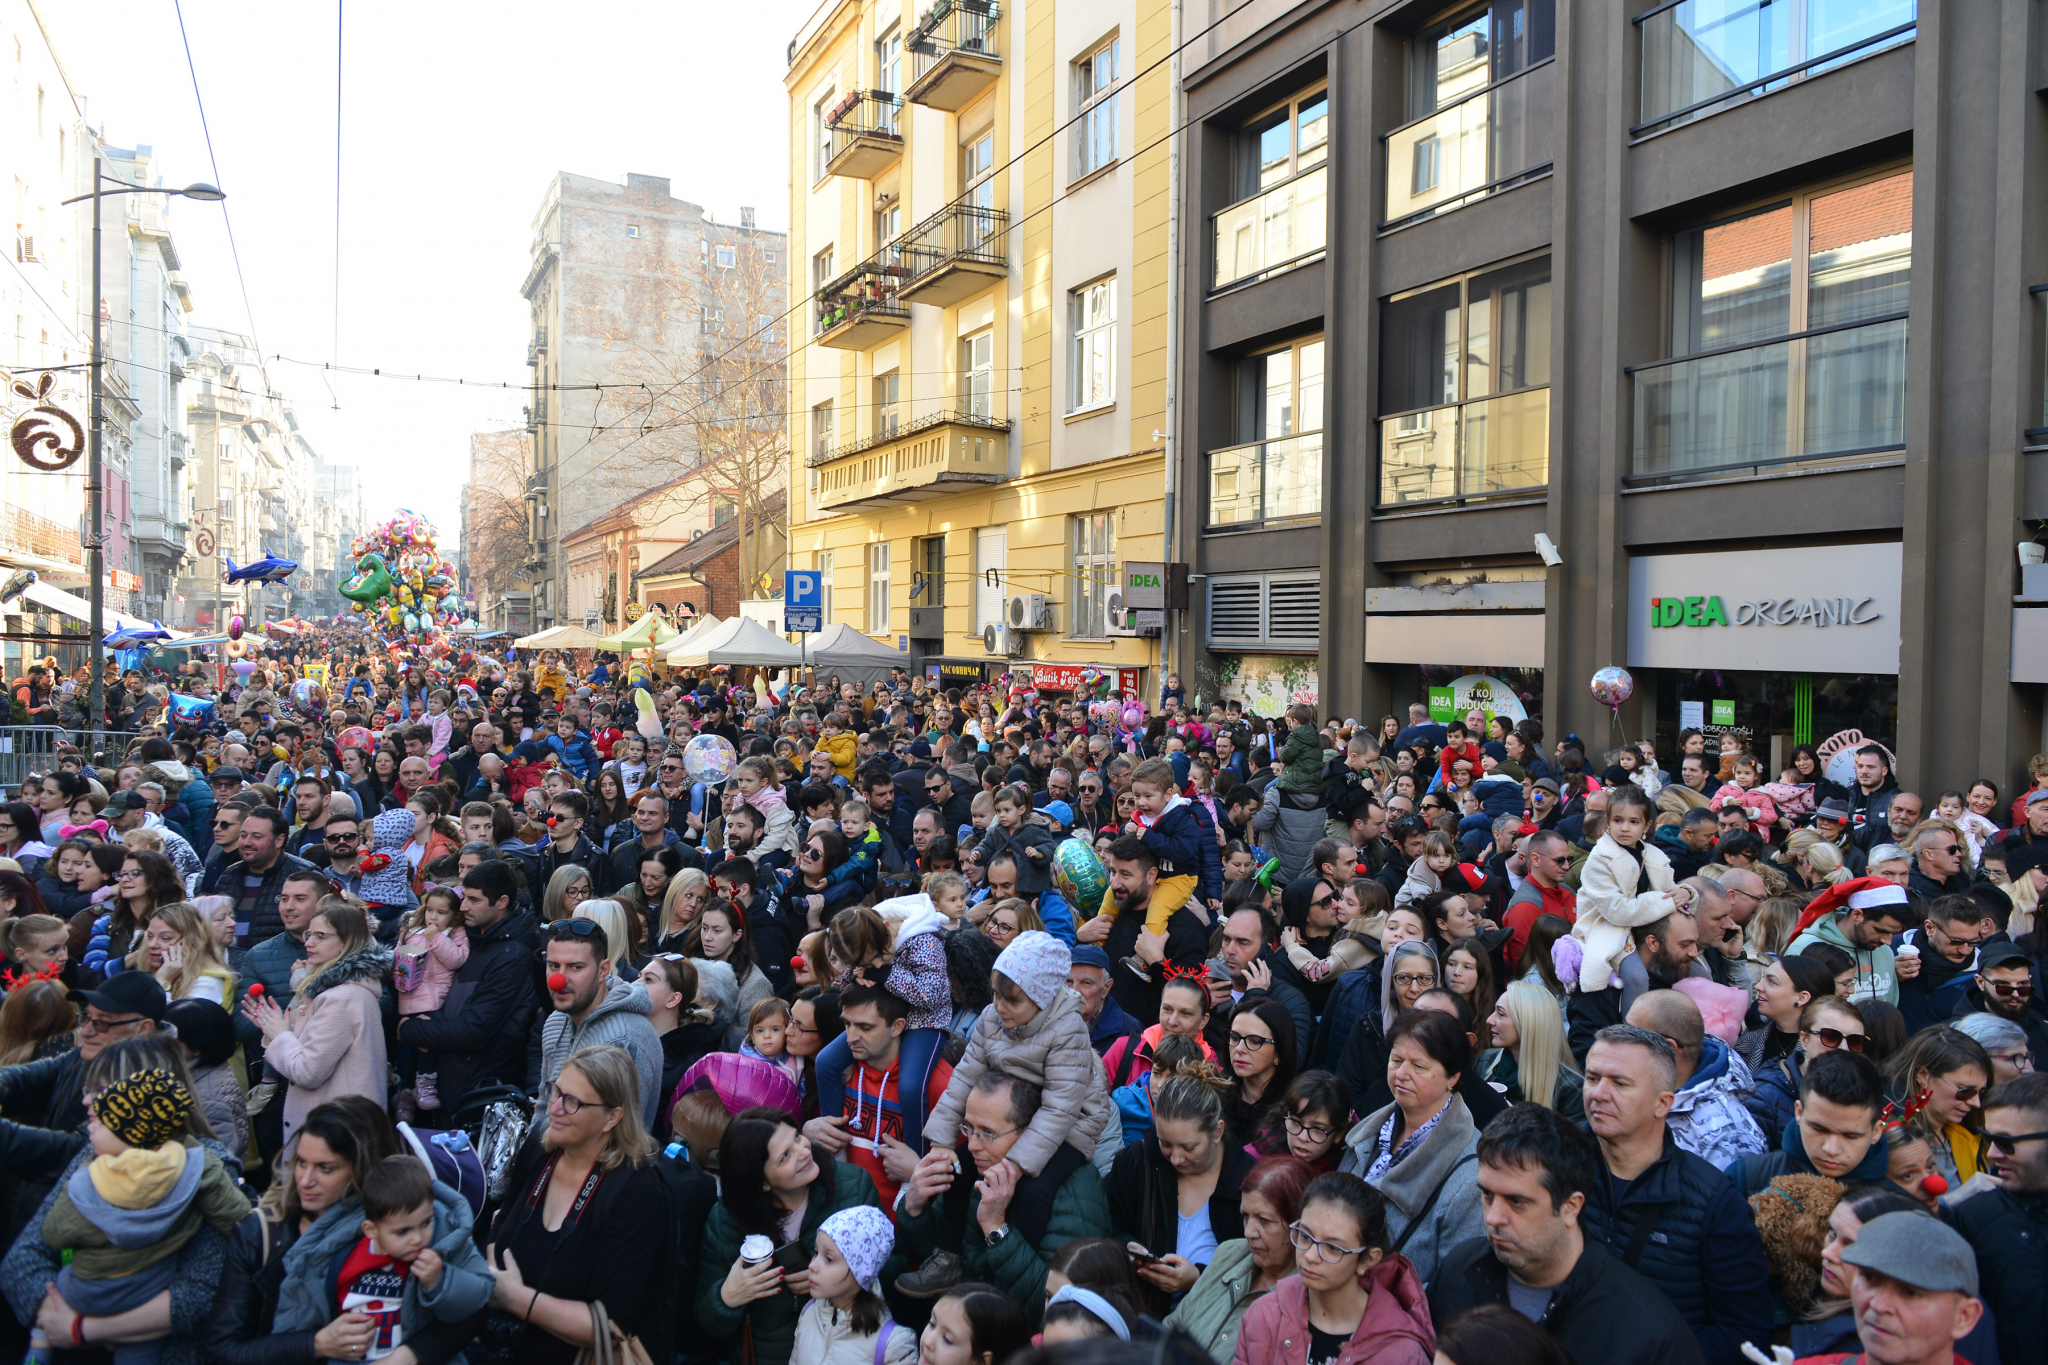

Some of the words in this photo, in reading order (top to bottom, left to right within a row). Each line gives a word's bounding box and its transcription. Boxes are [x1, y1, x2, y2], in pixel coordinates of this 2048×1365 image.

[1733, 597, 1881, 628] ORGANIC
[940, 665, 980, 676] ЧАСОВНИЧАР
[1034, 668, 1059, 685] Butik
[1123, 672, 1138, 702] ejsi
[1456, 688, 1475, 698] SVET
[1477, 688, 1495, 699] KOJI
[1496, 690, 1513, 700] IMA
[1455, 699, 1513, 714] BUDUĆNOST
[1818, 731, 1861, 762] NOVO
[581, 1174, 599, 1198] EOS
[574, 1198, 586, 1211] 7D
